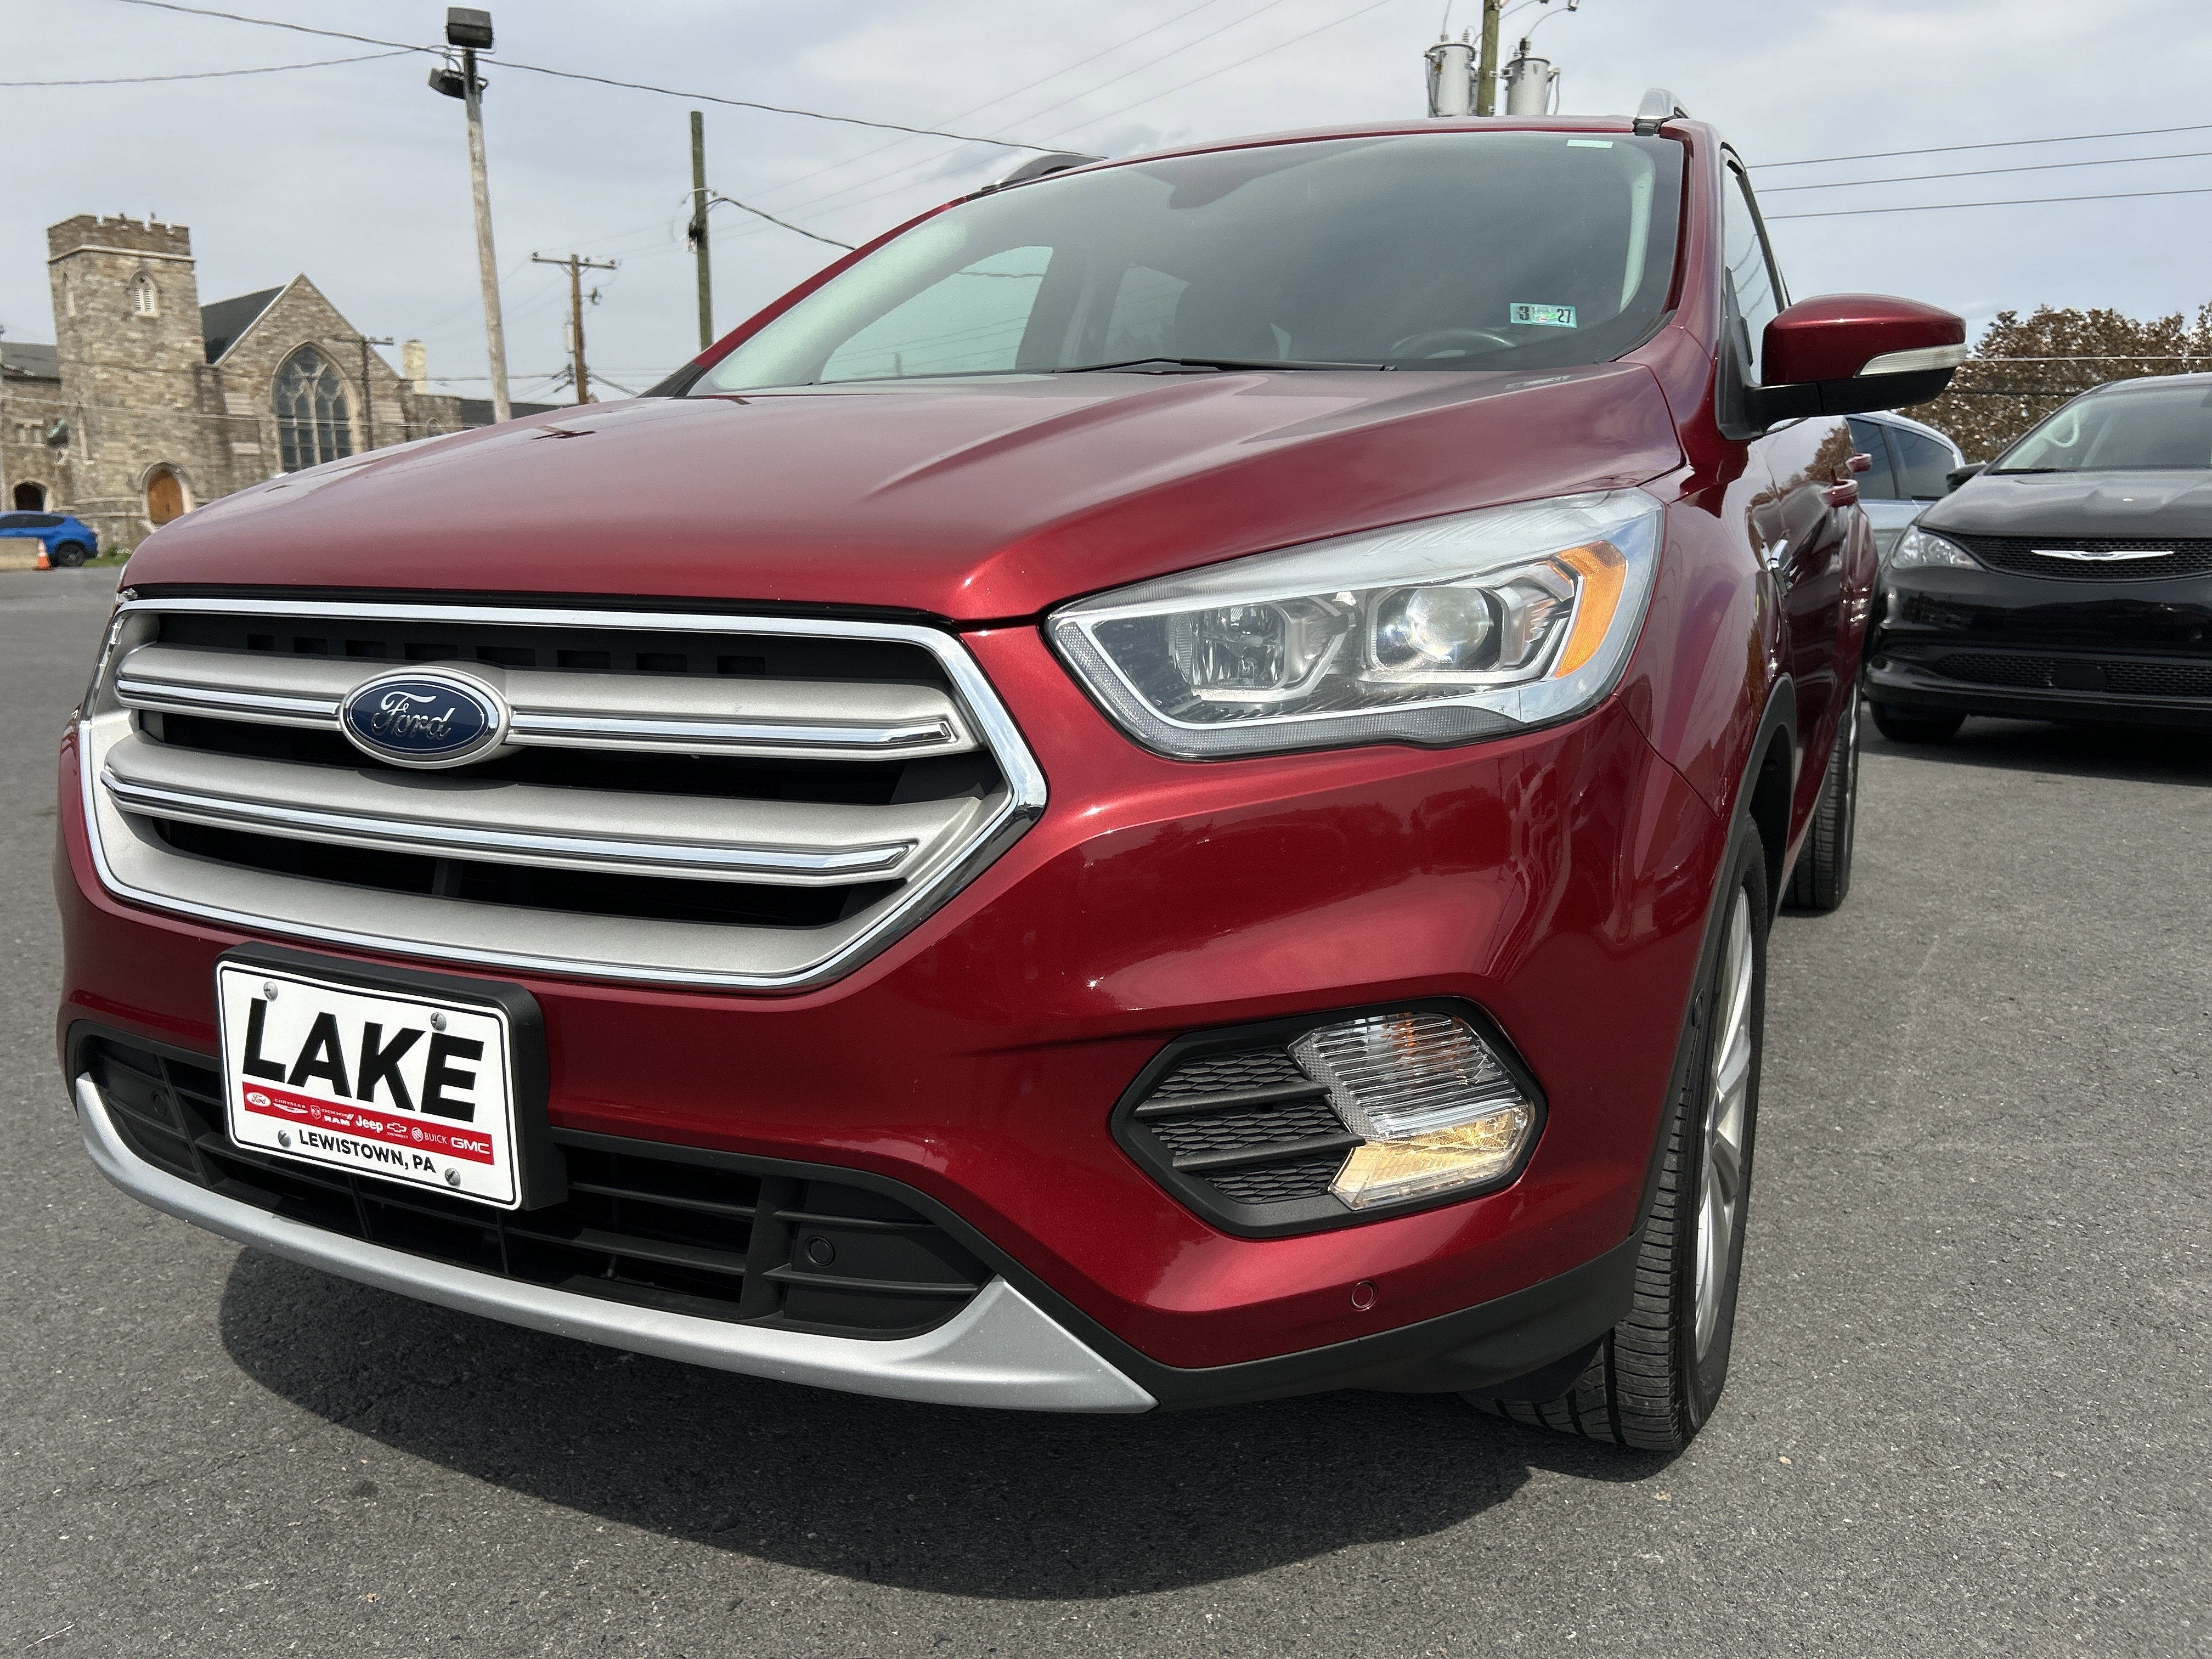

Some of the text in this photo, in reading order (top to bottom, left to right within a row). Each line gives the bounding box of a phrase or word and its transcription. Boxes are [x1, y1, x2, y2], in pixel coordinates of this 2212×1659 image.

[1519, 306, 1530, 321] 3
[1556, 308, 1571, 324] 27
[370, 691, 456, 741] Ford
[242, 997, 484, 1122] LAKE
[251, 1094, 266, 1104] Ford
[324, 1115, 351, 1126] RAM
[355, 1115, 383, 1133] Jeep
[424, 1132, 448, 1145] BUICK
[450, 1137, 490, 1155] GMC
[298, 1129, 437, 1173] LEWISTOWN, PA
